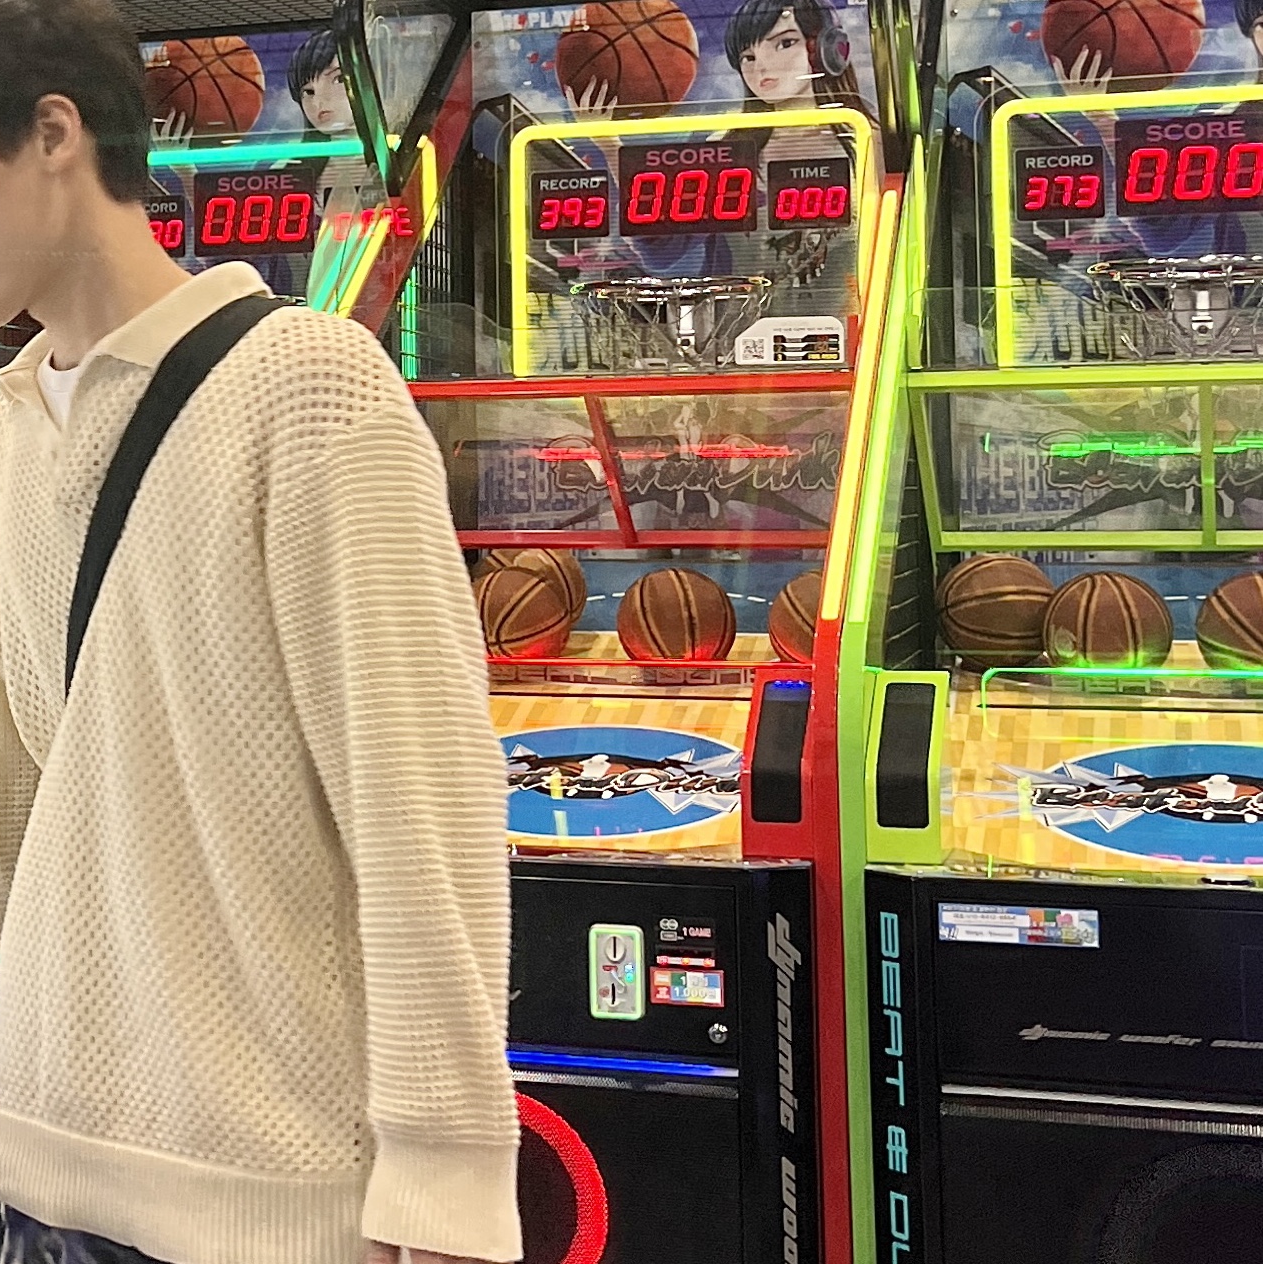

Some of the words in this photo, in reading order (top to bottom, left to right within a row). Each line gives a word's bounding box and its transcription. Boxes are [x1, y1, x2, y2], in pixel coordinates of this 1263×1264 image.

[1145, 120, 1246, 143] SCORE
[645, 147, 733, 166] SCORE
[1025, 154, 1094, 169] RECORD
[217, 174, 295, 193] SCORE
[539, 177, 601, 191] RECORD
[789, 165, 830, 179] TIME
[1124, 142, 1263, 203] 000
[626, 168, 753, 225] 000
[775, 186, 847, 220] 000
[1024, 175, 1100, 210] 373
[145, 202, 178, 213] CORD
[201, 193, 313, 244] 000
[539, 197, 605, 229] 393
[880, 911, 905, 1107] BEAT
